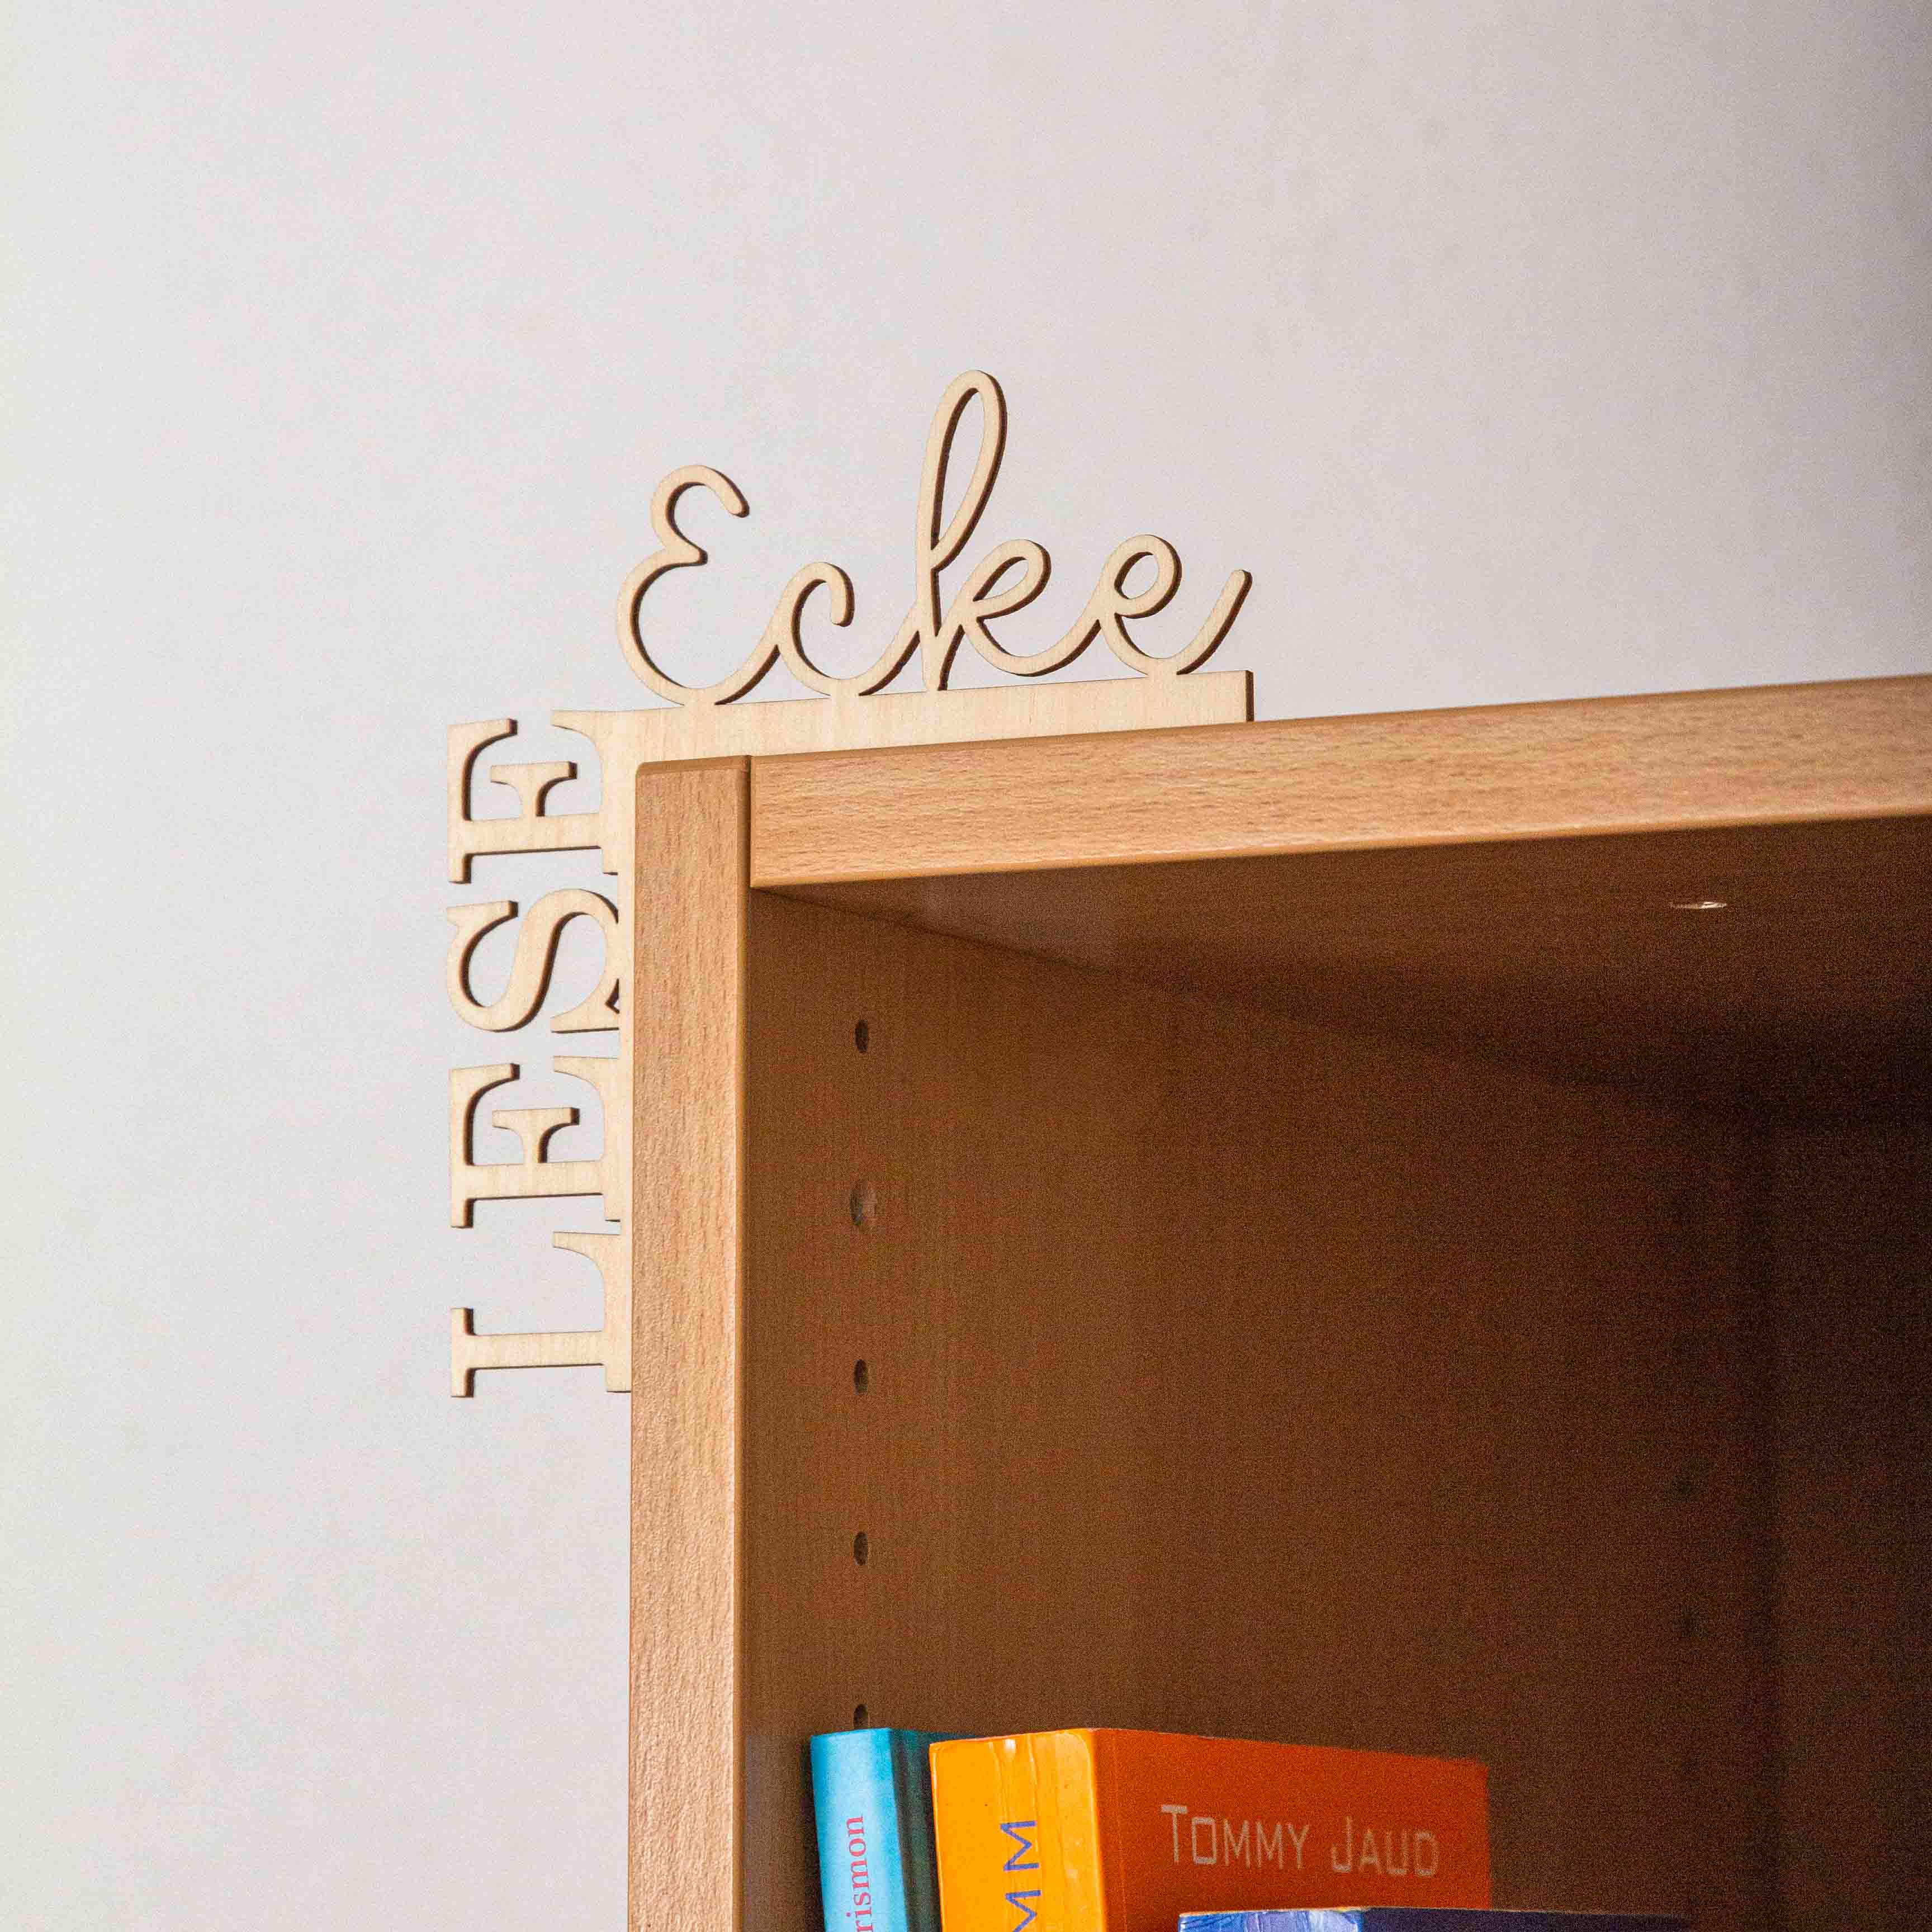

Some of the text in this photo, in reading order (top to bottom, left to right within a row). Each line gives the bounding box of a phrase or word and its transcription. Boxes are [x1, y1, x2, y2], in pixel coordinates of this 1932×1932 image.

[616, 369, 1253, 707] Ecke
[446, 709, 635, 1398] LESE
[1161, 1804, 1441, 1878] TOMMY JAUD
